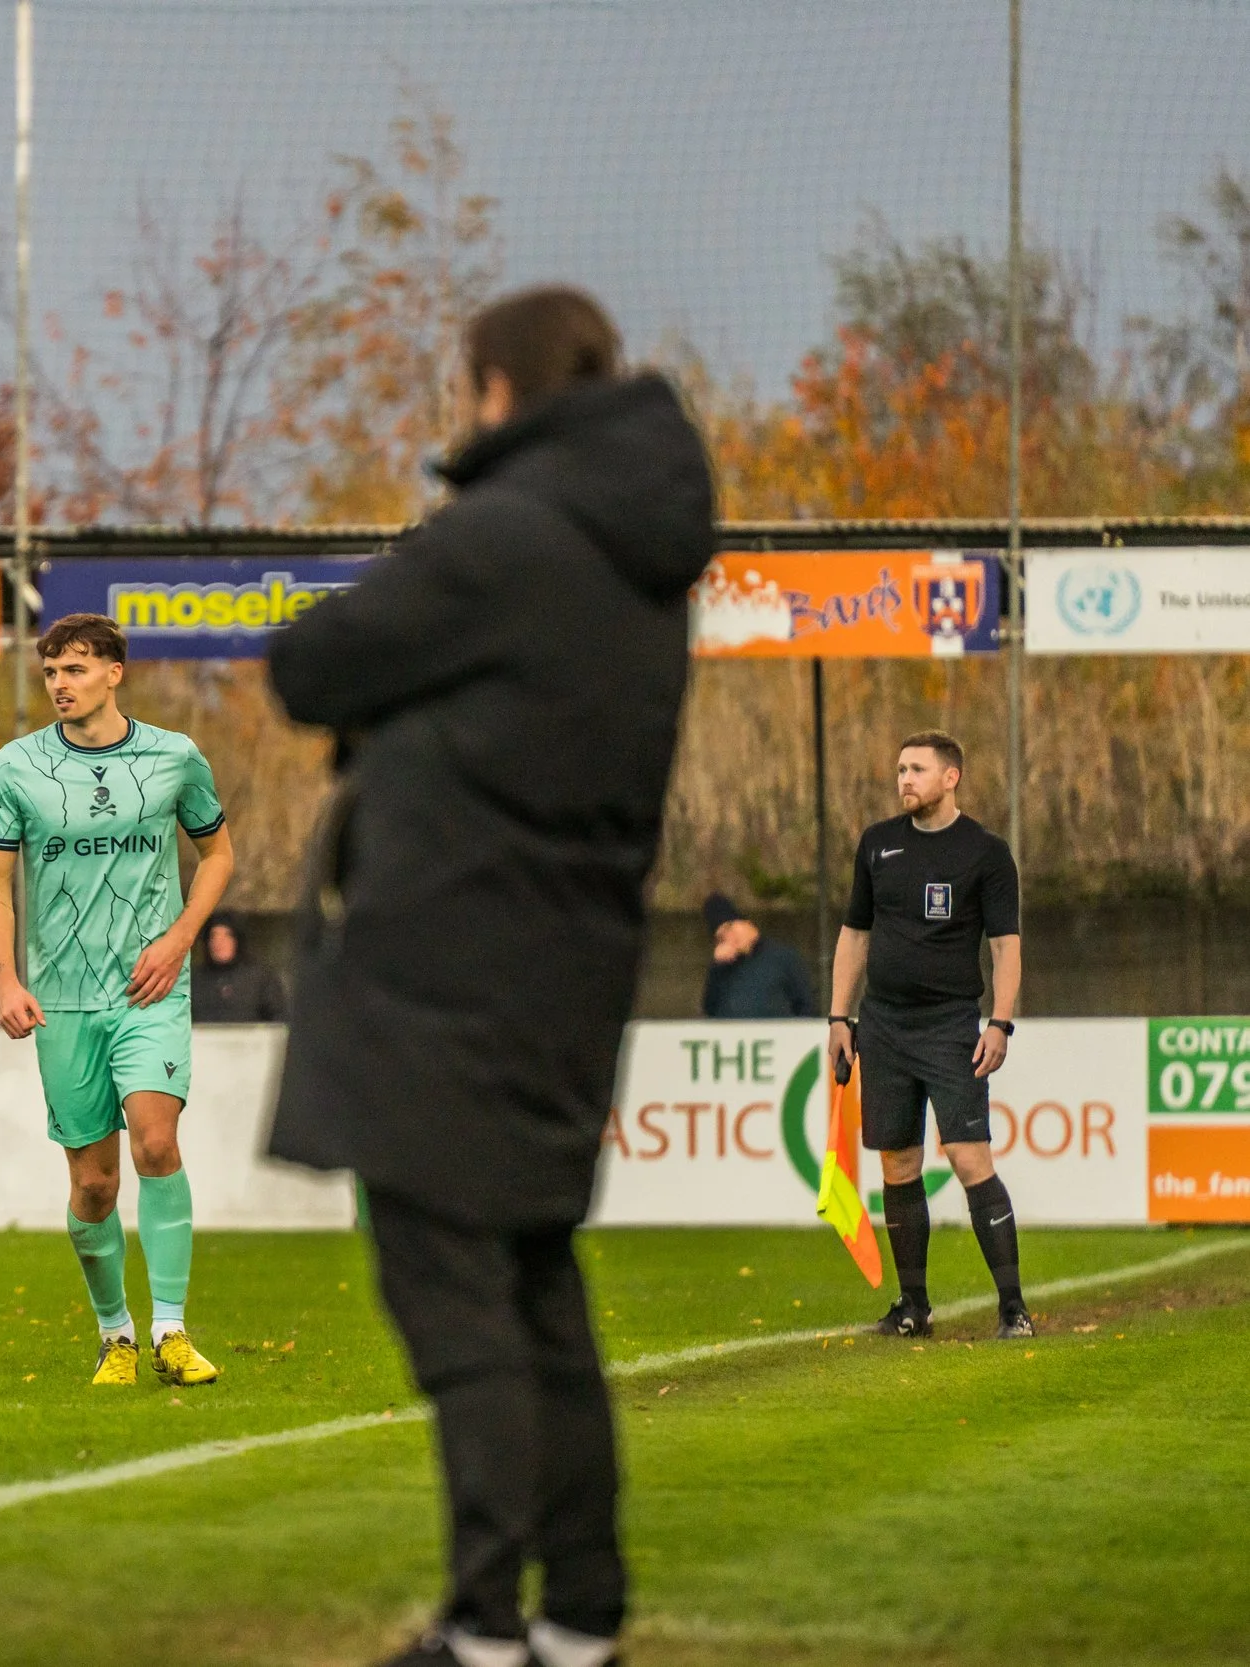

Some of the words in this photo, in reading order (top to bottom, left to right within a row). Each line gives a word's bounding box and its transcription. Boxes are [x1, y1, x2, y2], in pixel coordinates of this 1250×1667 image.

[116, 579, 348, 628] mosele
[1159, 590, 1191, 609] The
[74, 834, 162, 856] GEMINI
[681, 1039, 776, 1083] THE
[936, 1101, 1118, 1159] OOR
